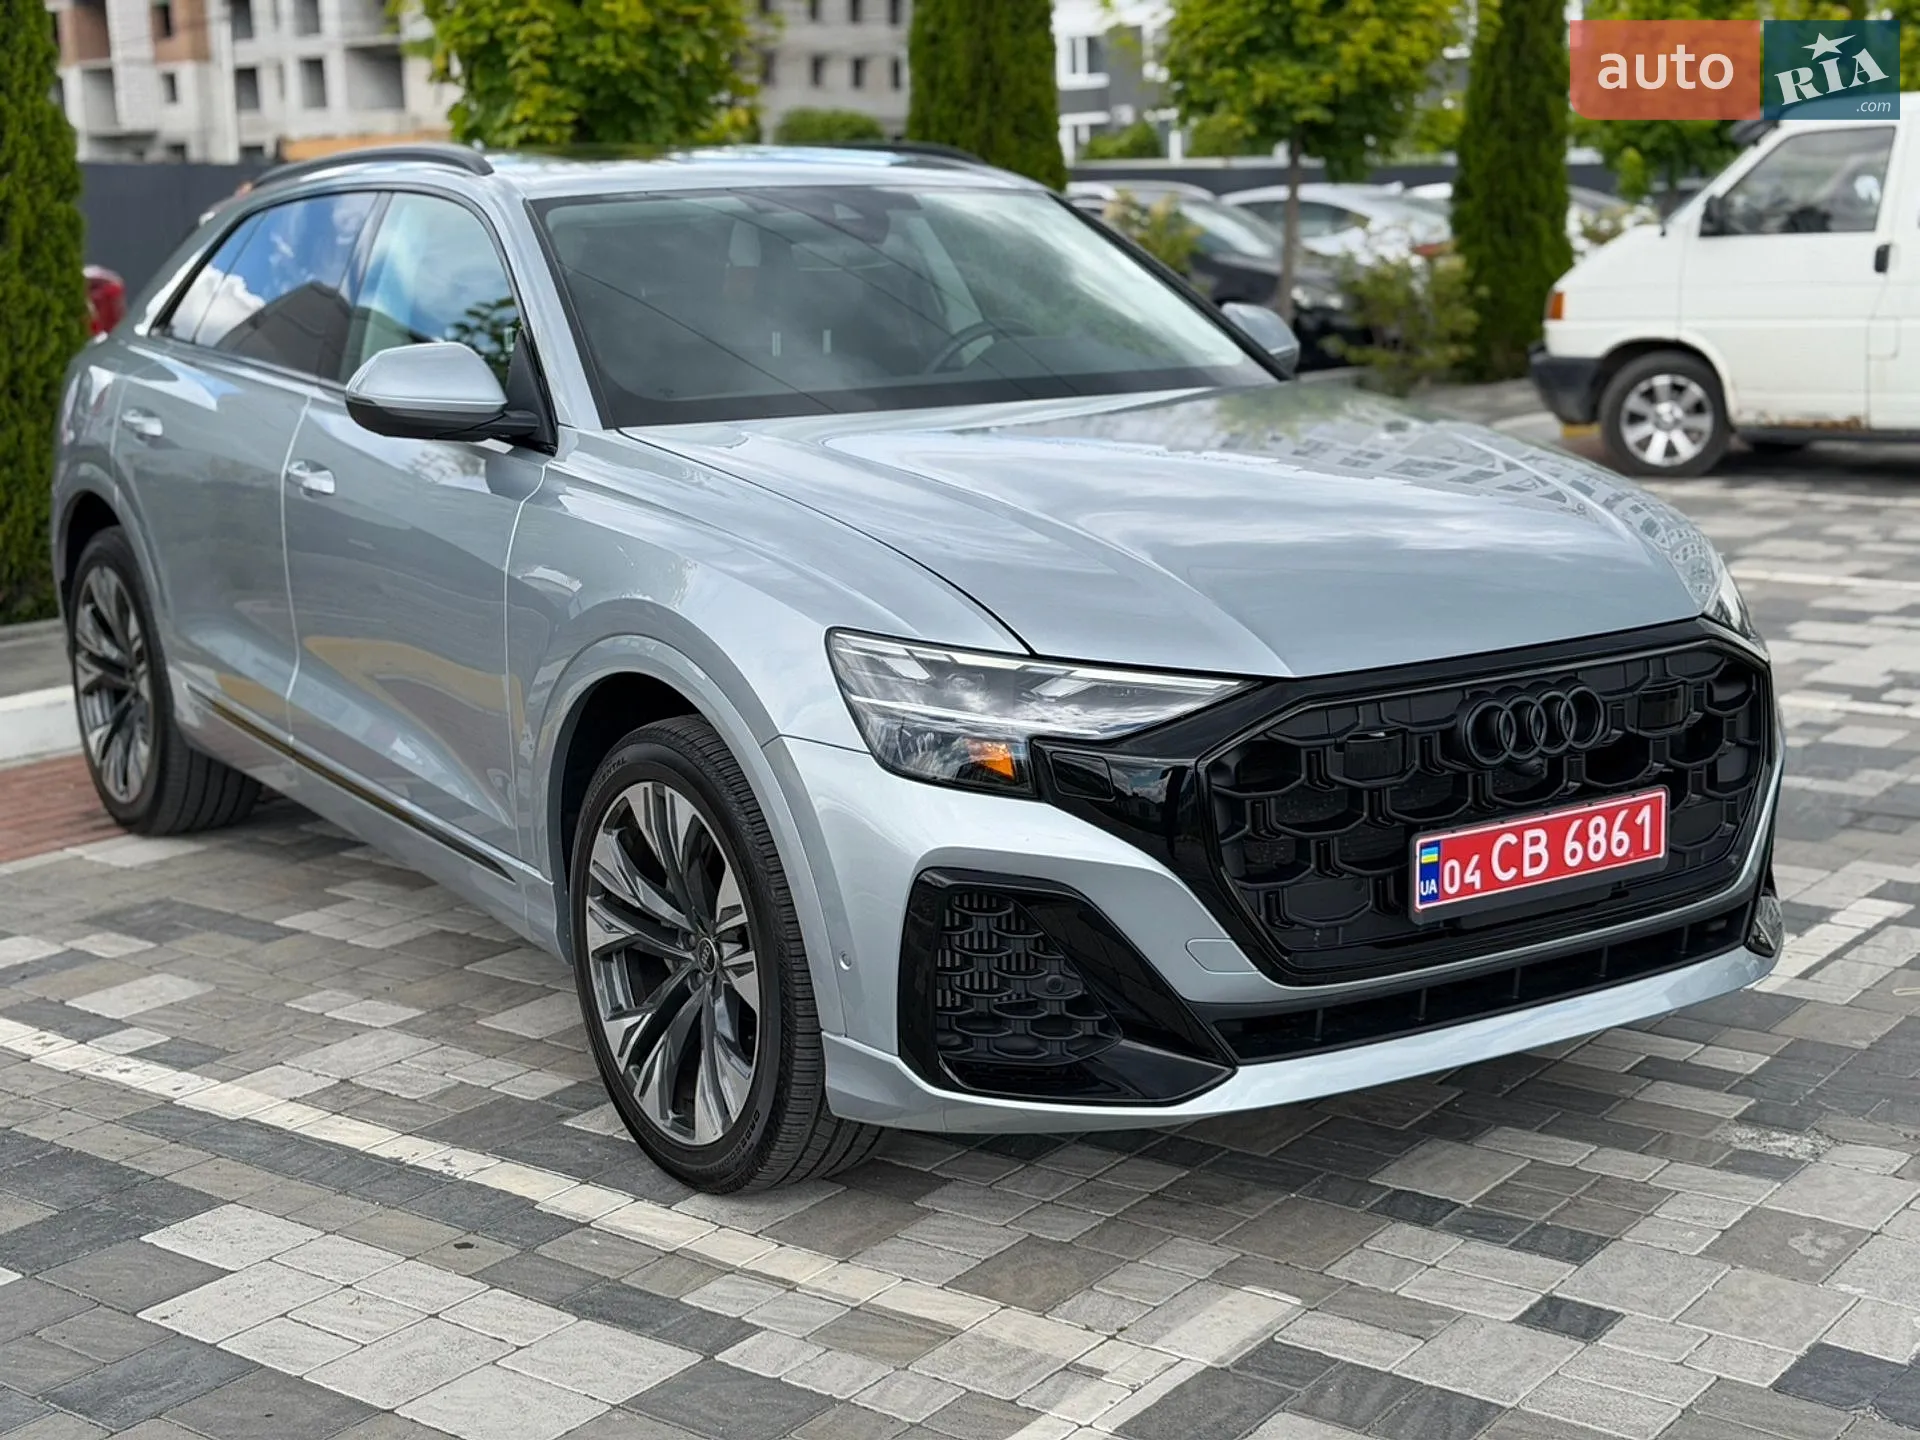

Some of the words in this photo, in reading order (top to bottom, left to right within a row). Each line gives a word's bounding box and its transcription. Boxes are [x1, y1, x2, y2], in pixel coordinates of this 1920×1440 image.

[1443, 854, 1482, 894] 04
[1491, 828, 1549, 881] CB
[1563, 804, 1652, 867] 6861
[1420, 879, 1438, 896] UA
